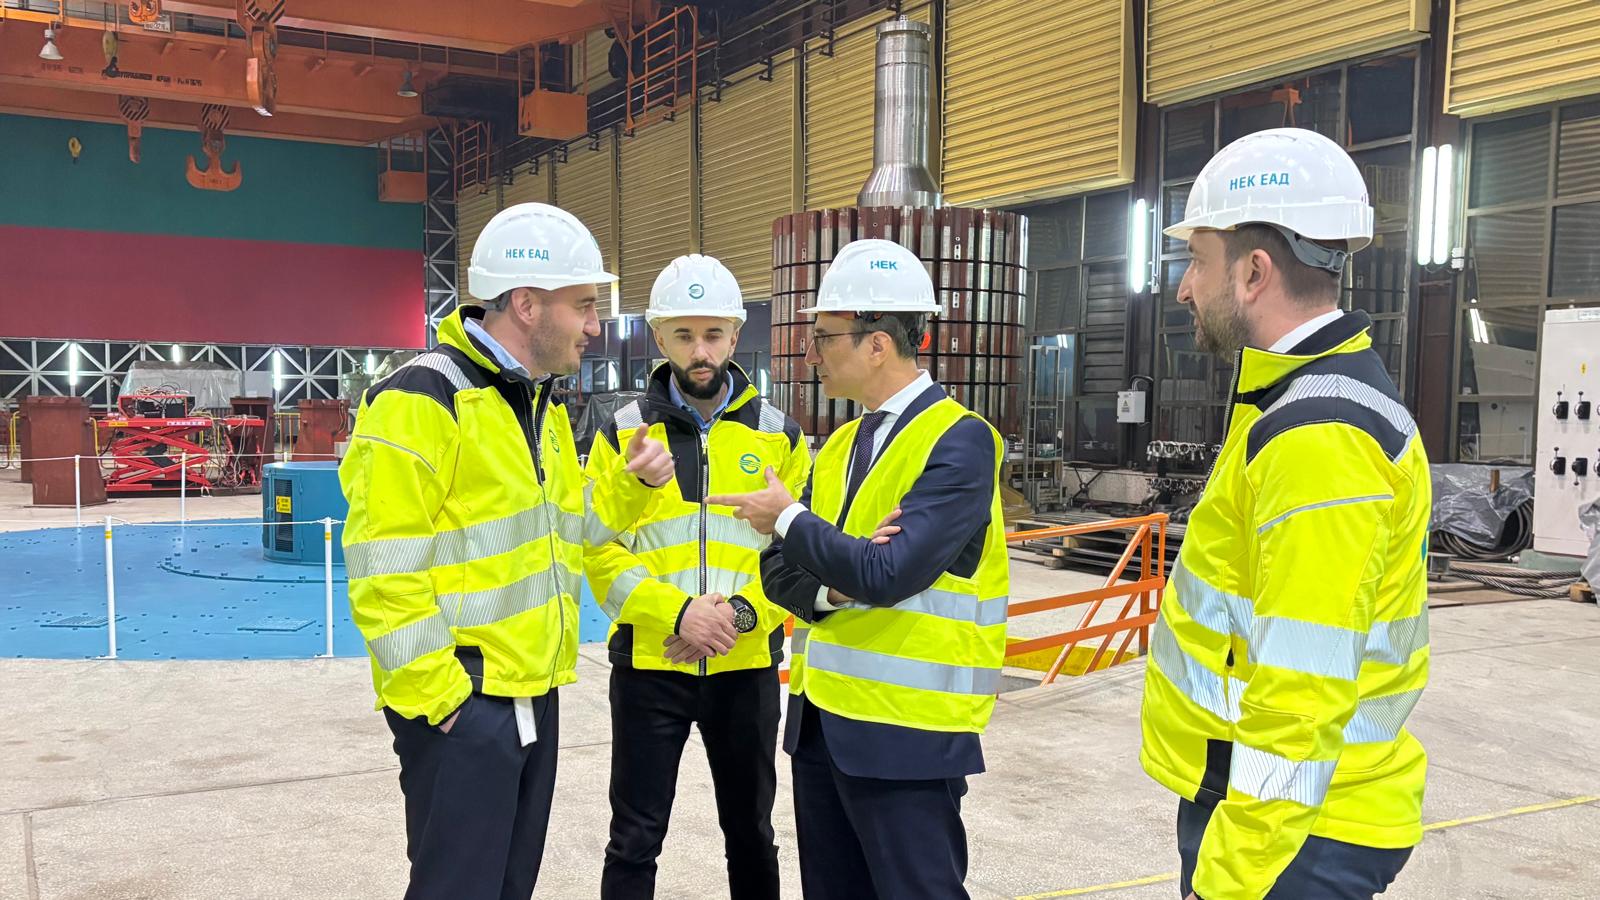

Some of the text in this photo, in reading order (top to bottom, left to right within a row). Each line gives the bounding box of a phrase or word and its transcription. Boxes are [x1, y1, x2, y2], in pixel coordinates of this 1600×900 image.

[1230, 172, 1290, 190] НЕК ЕАД
[505, 248, 550, 261] НЕК ЕАД
[870, 260, 898, 270] НЕК
